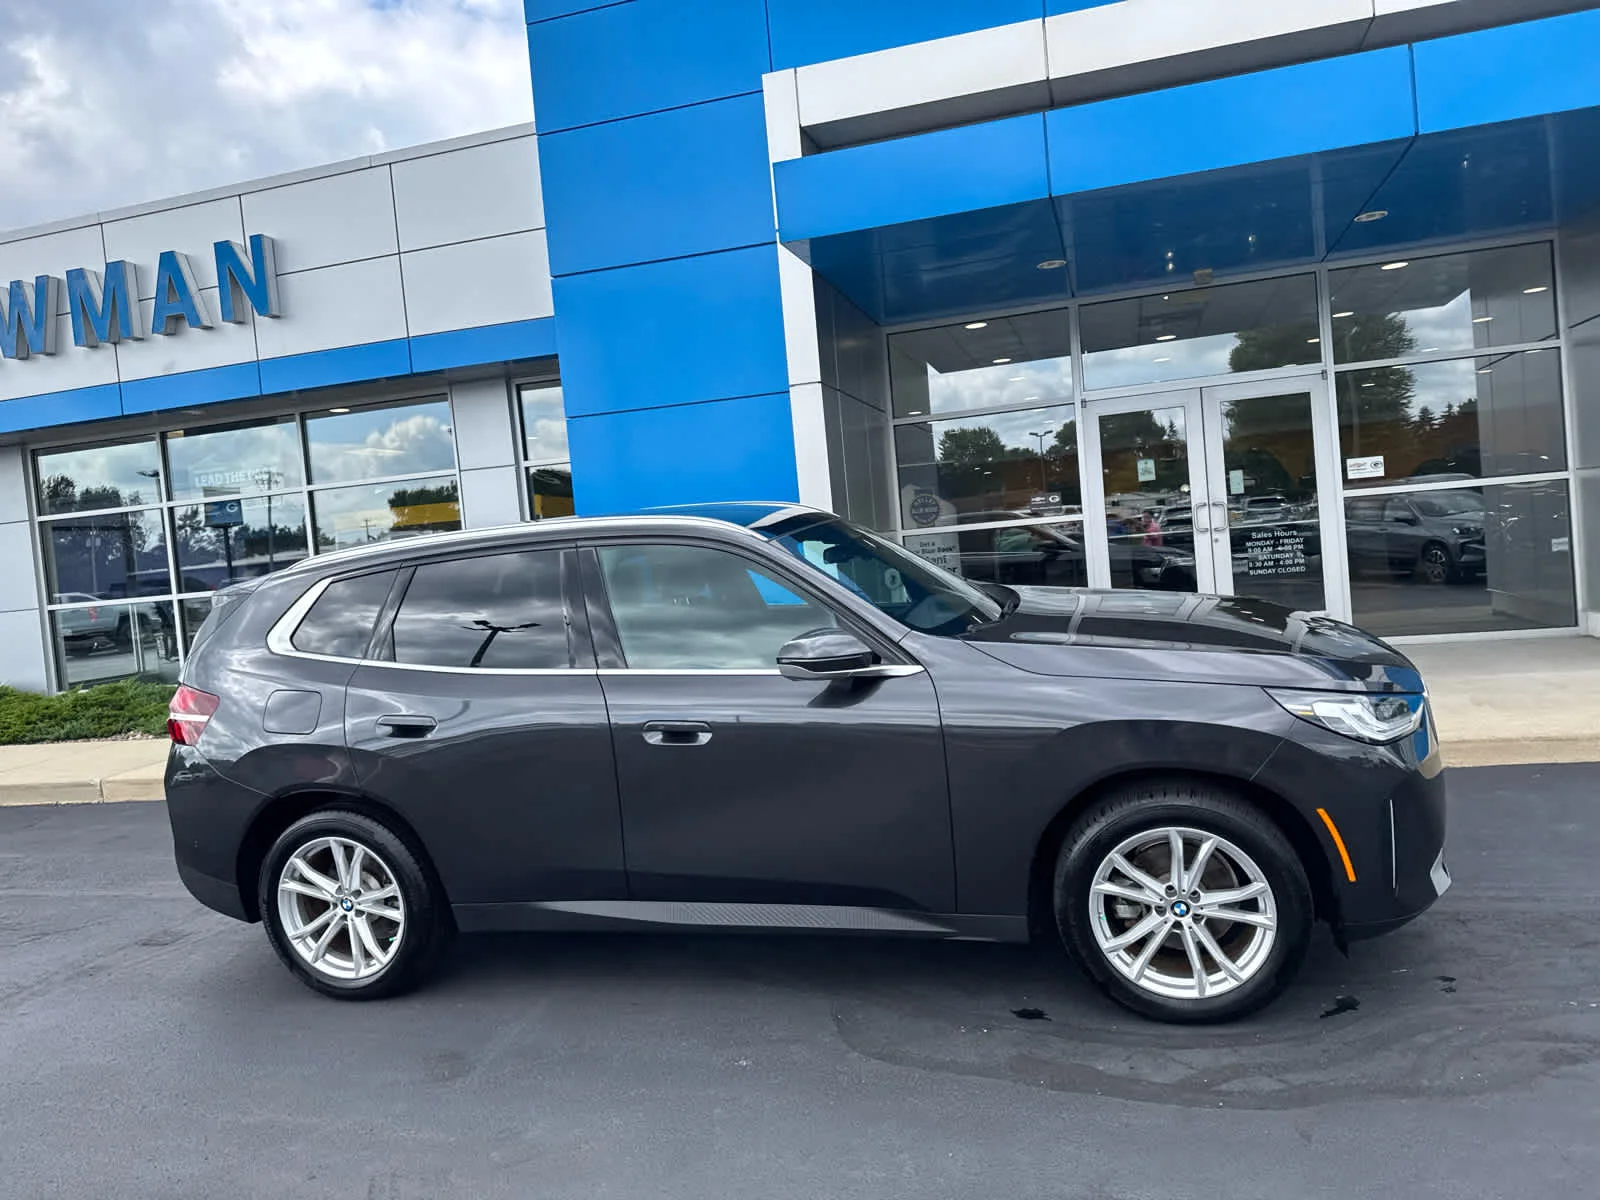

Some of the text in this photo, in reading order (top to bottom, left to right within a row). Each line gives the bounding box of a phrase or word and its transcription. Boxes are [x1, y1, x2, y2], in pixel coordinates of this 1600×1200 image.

[1251, 530, 1297, 539] Sales Hours
[1280, 537, 1304, 545] FRIDAY
[1258, 552, 1294, 560] SATURDAY
[1249, 565, 1306, 576] SUNDAY CLOSED
